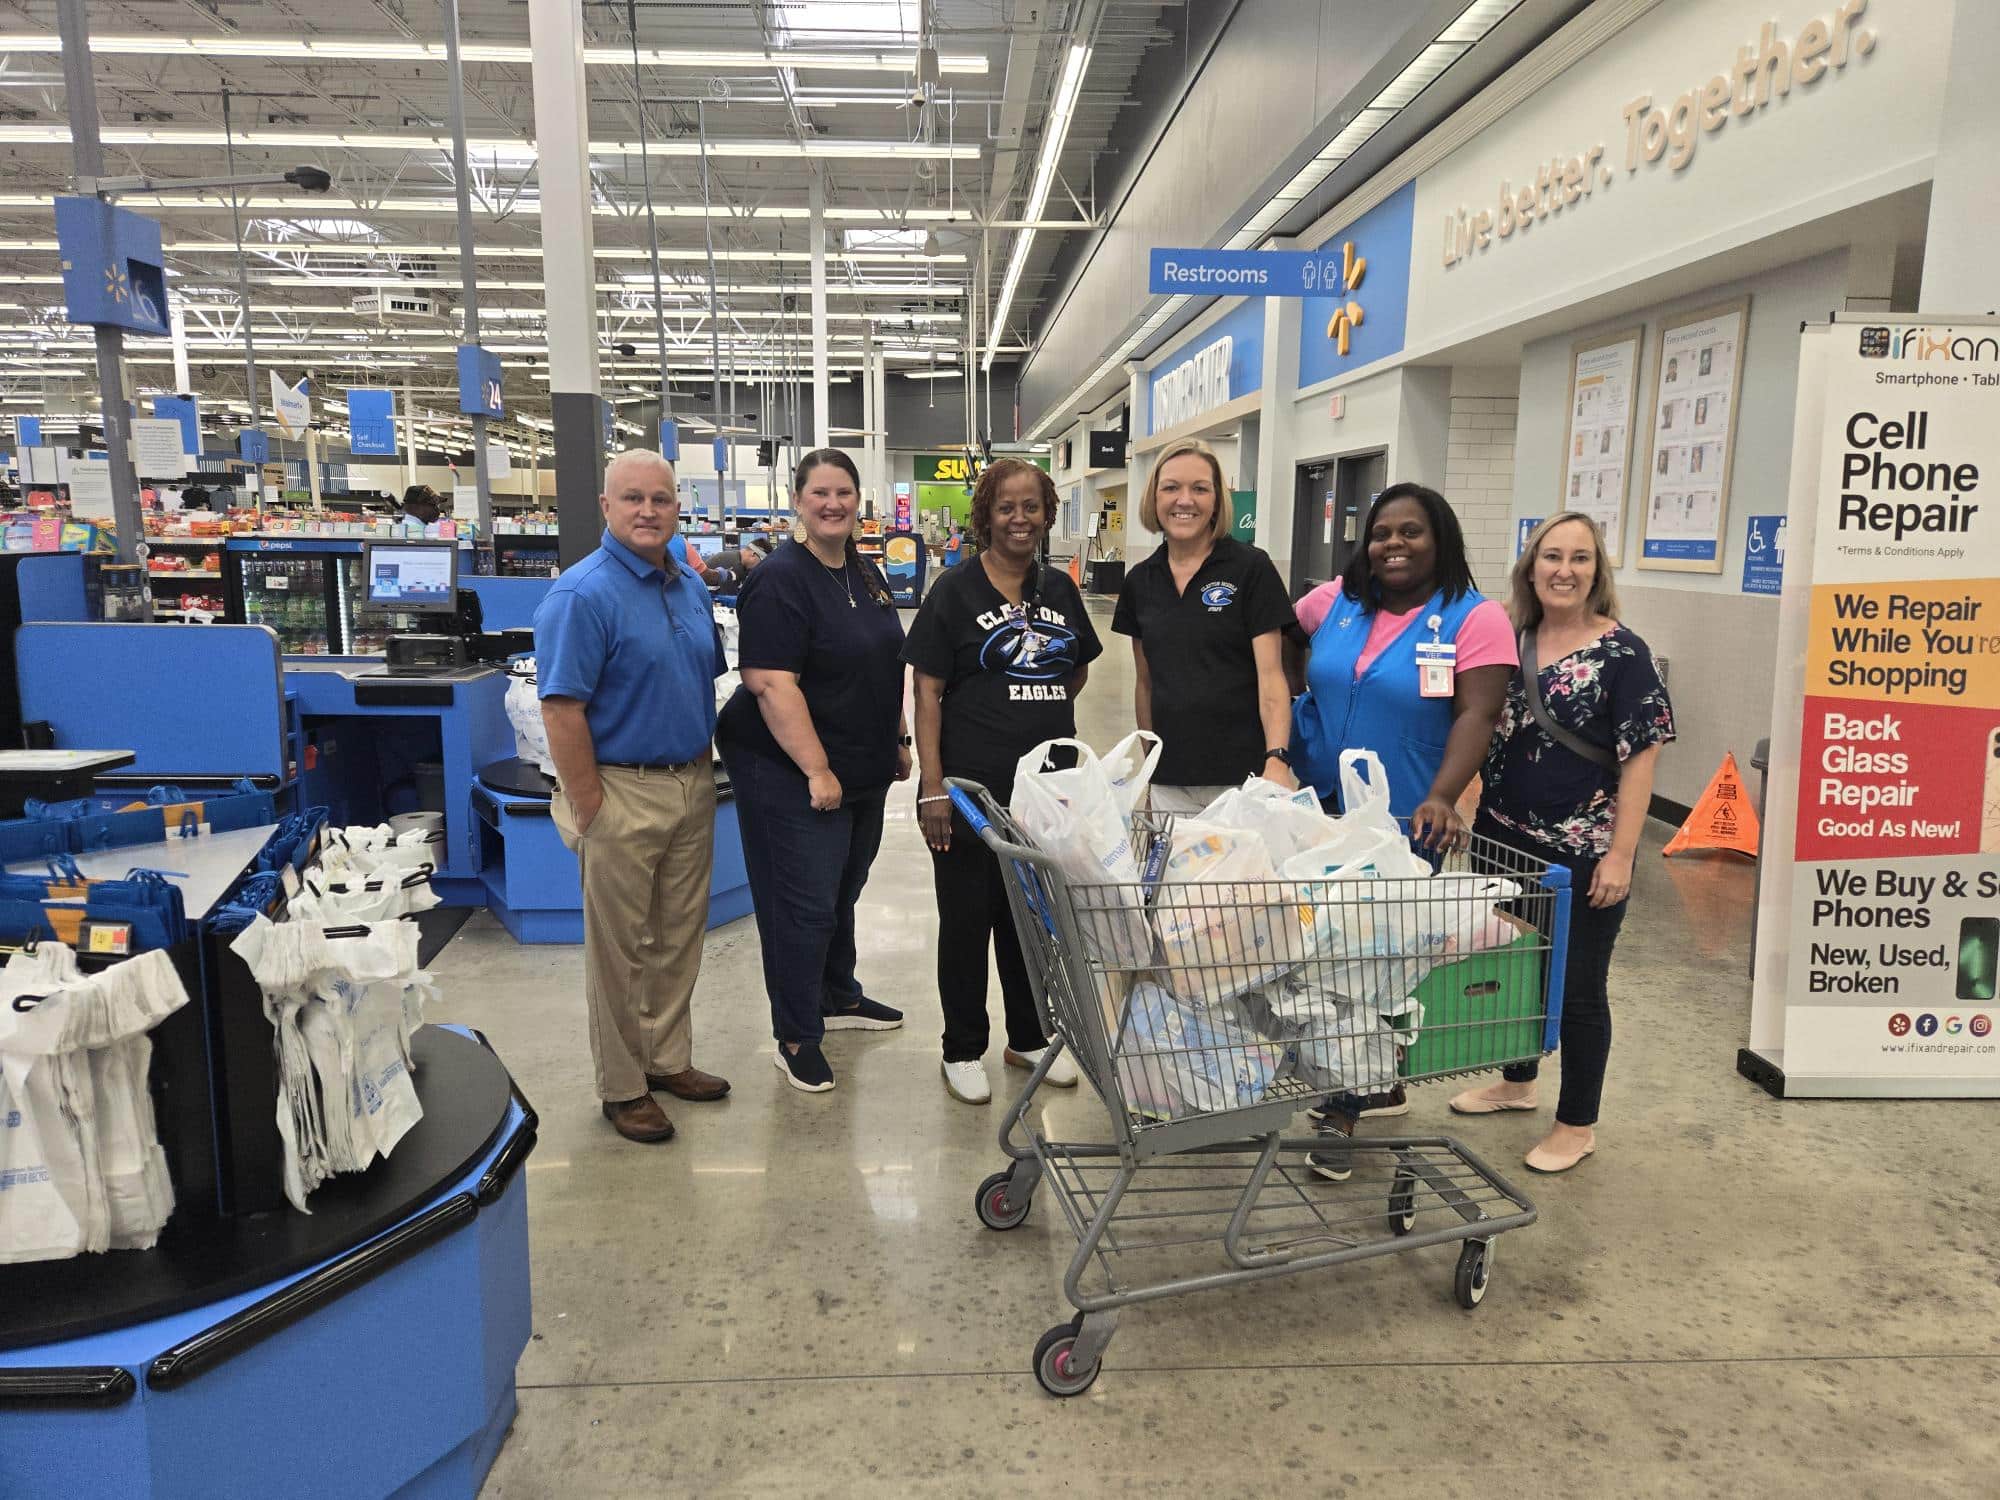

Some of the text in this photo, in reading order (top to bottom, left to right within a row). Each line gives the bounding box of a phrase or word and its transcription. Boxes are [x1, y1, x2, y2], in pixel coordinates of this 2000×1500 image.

[1442, 0, 1877, 267] Live better. Together.
[1163, 261, 1268, 284] Restrooms
[1875, 372, 1959, 387] Smartphone
[489, 381, 502, 410] 24
[1846, 411, 1928, 450] Cell
[1841, 452, 1979, 492] Phone
[1838, 494, 1978, 541] Repair
[1875, 547, 1881, 556] &
[1884, 546, 1935, 556] Conditions
[1937, 547, 1965, 558] Apply
[976, 601, 1066, 631] CLAON
[1834, 594, 1982, 628] We Repair
[1831, 627, 1911, 654] While
[1828, 659, 1967, 695] Shopping
[1008, 685, 1067, 701] EAGLES
[1823, 713, 1901, 741] Back
[1822, 746, 1909, 774] Glass
[1819, 778, 1919, 814] Repair
[1817, 818, 1960, 839] Good As New!
[1816, 869, 2000, 904] We Buy & S
[1812, 900, 1930, 928] Phones
[1810, 943, 1950, 970] New, Used,
[1809, 971, 1899, 993] Broken
[1881, 1043, 1996, 1056] www.ifixandrepair.com
